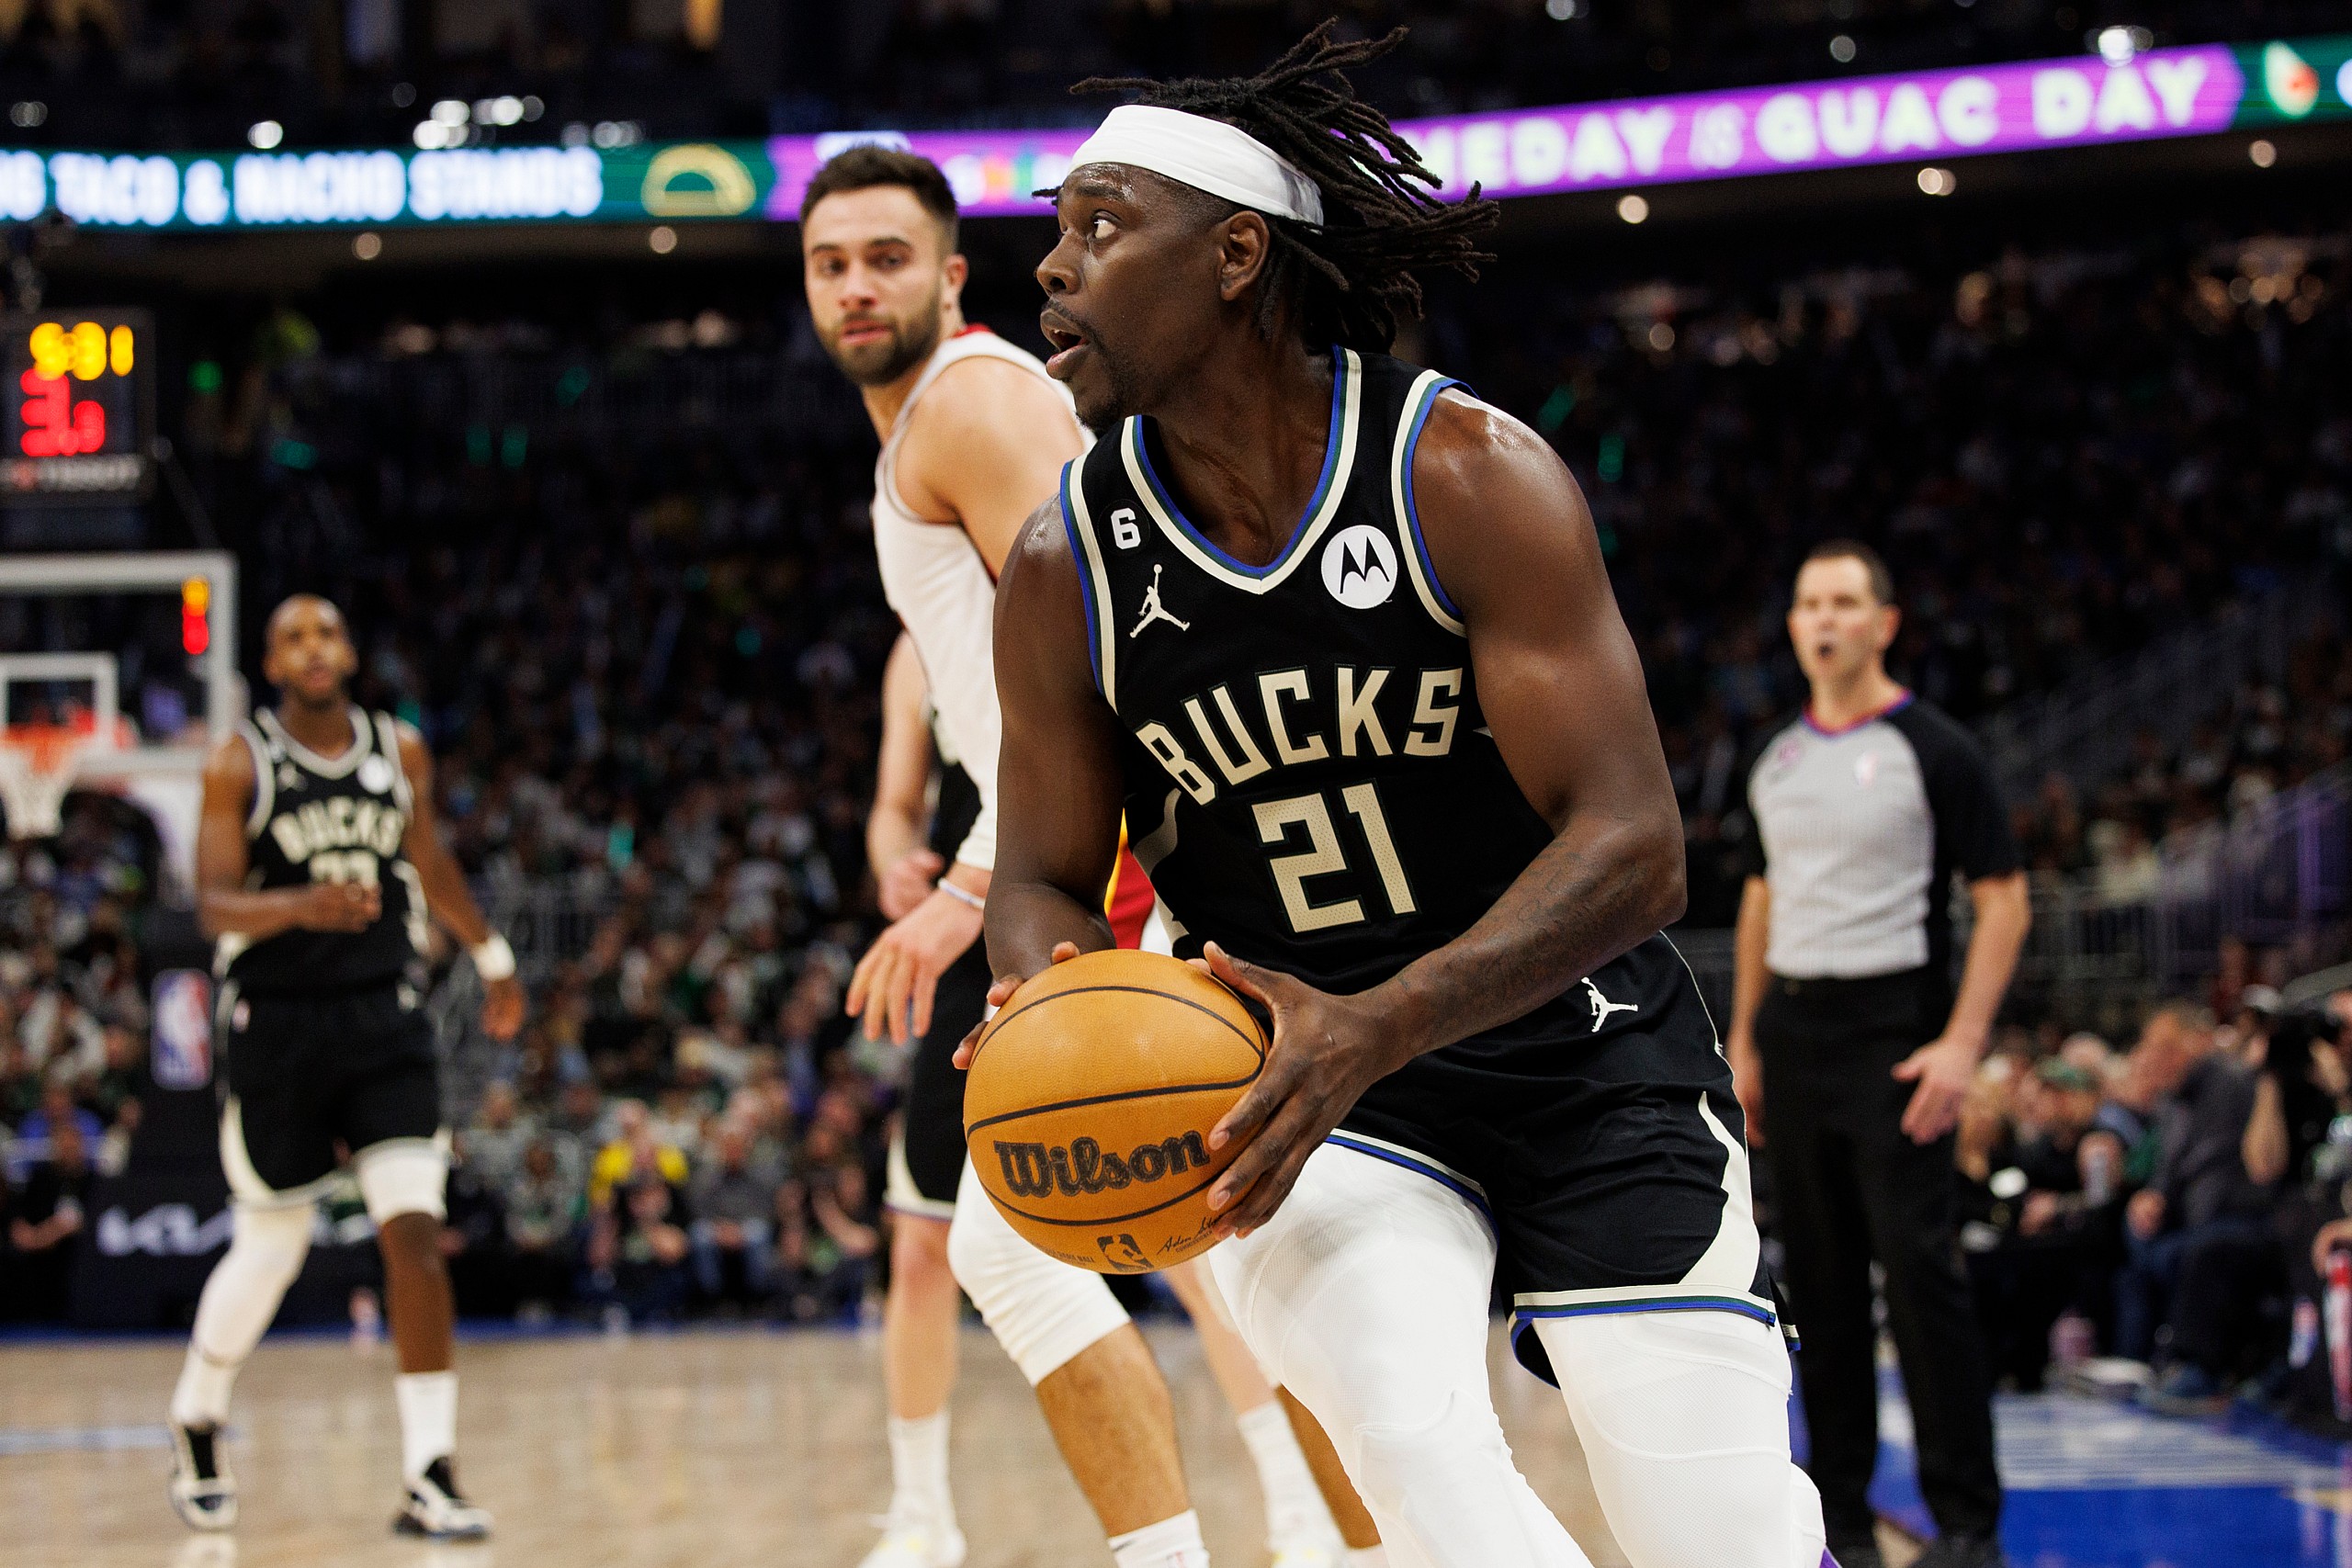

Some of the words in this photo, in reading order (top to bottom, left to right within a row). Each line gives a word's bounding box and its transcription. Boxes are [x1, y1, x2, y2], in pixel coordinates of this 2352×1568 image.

[1396, 103, 1674, 195] MEDAY
[1755, 75, 2001, 164] GUAC
[2030, 55, 2207, 140] DAY
[408, 145, 604, 221] STANDS
[1110, 507, 1141, 550] 6
[1133, 663, 1464, 807] BUCKS
[270, 795, 405, 863] BUCKS
[1250, 779, 1422, 934] 21
[993, 1130, 1211, 1198] Wilson
